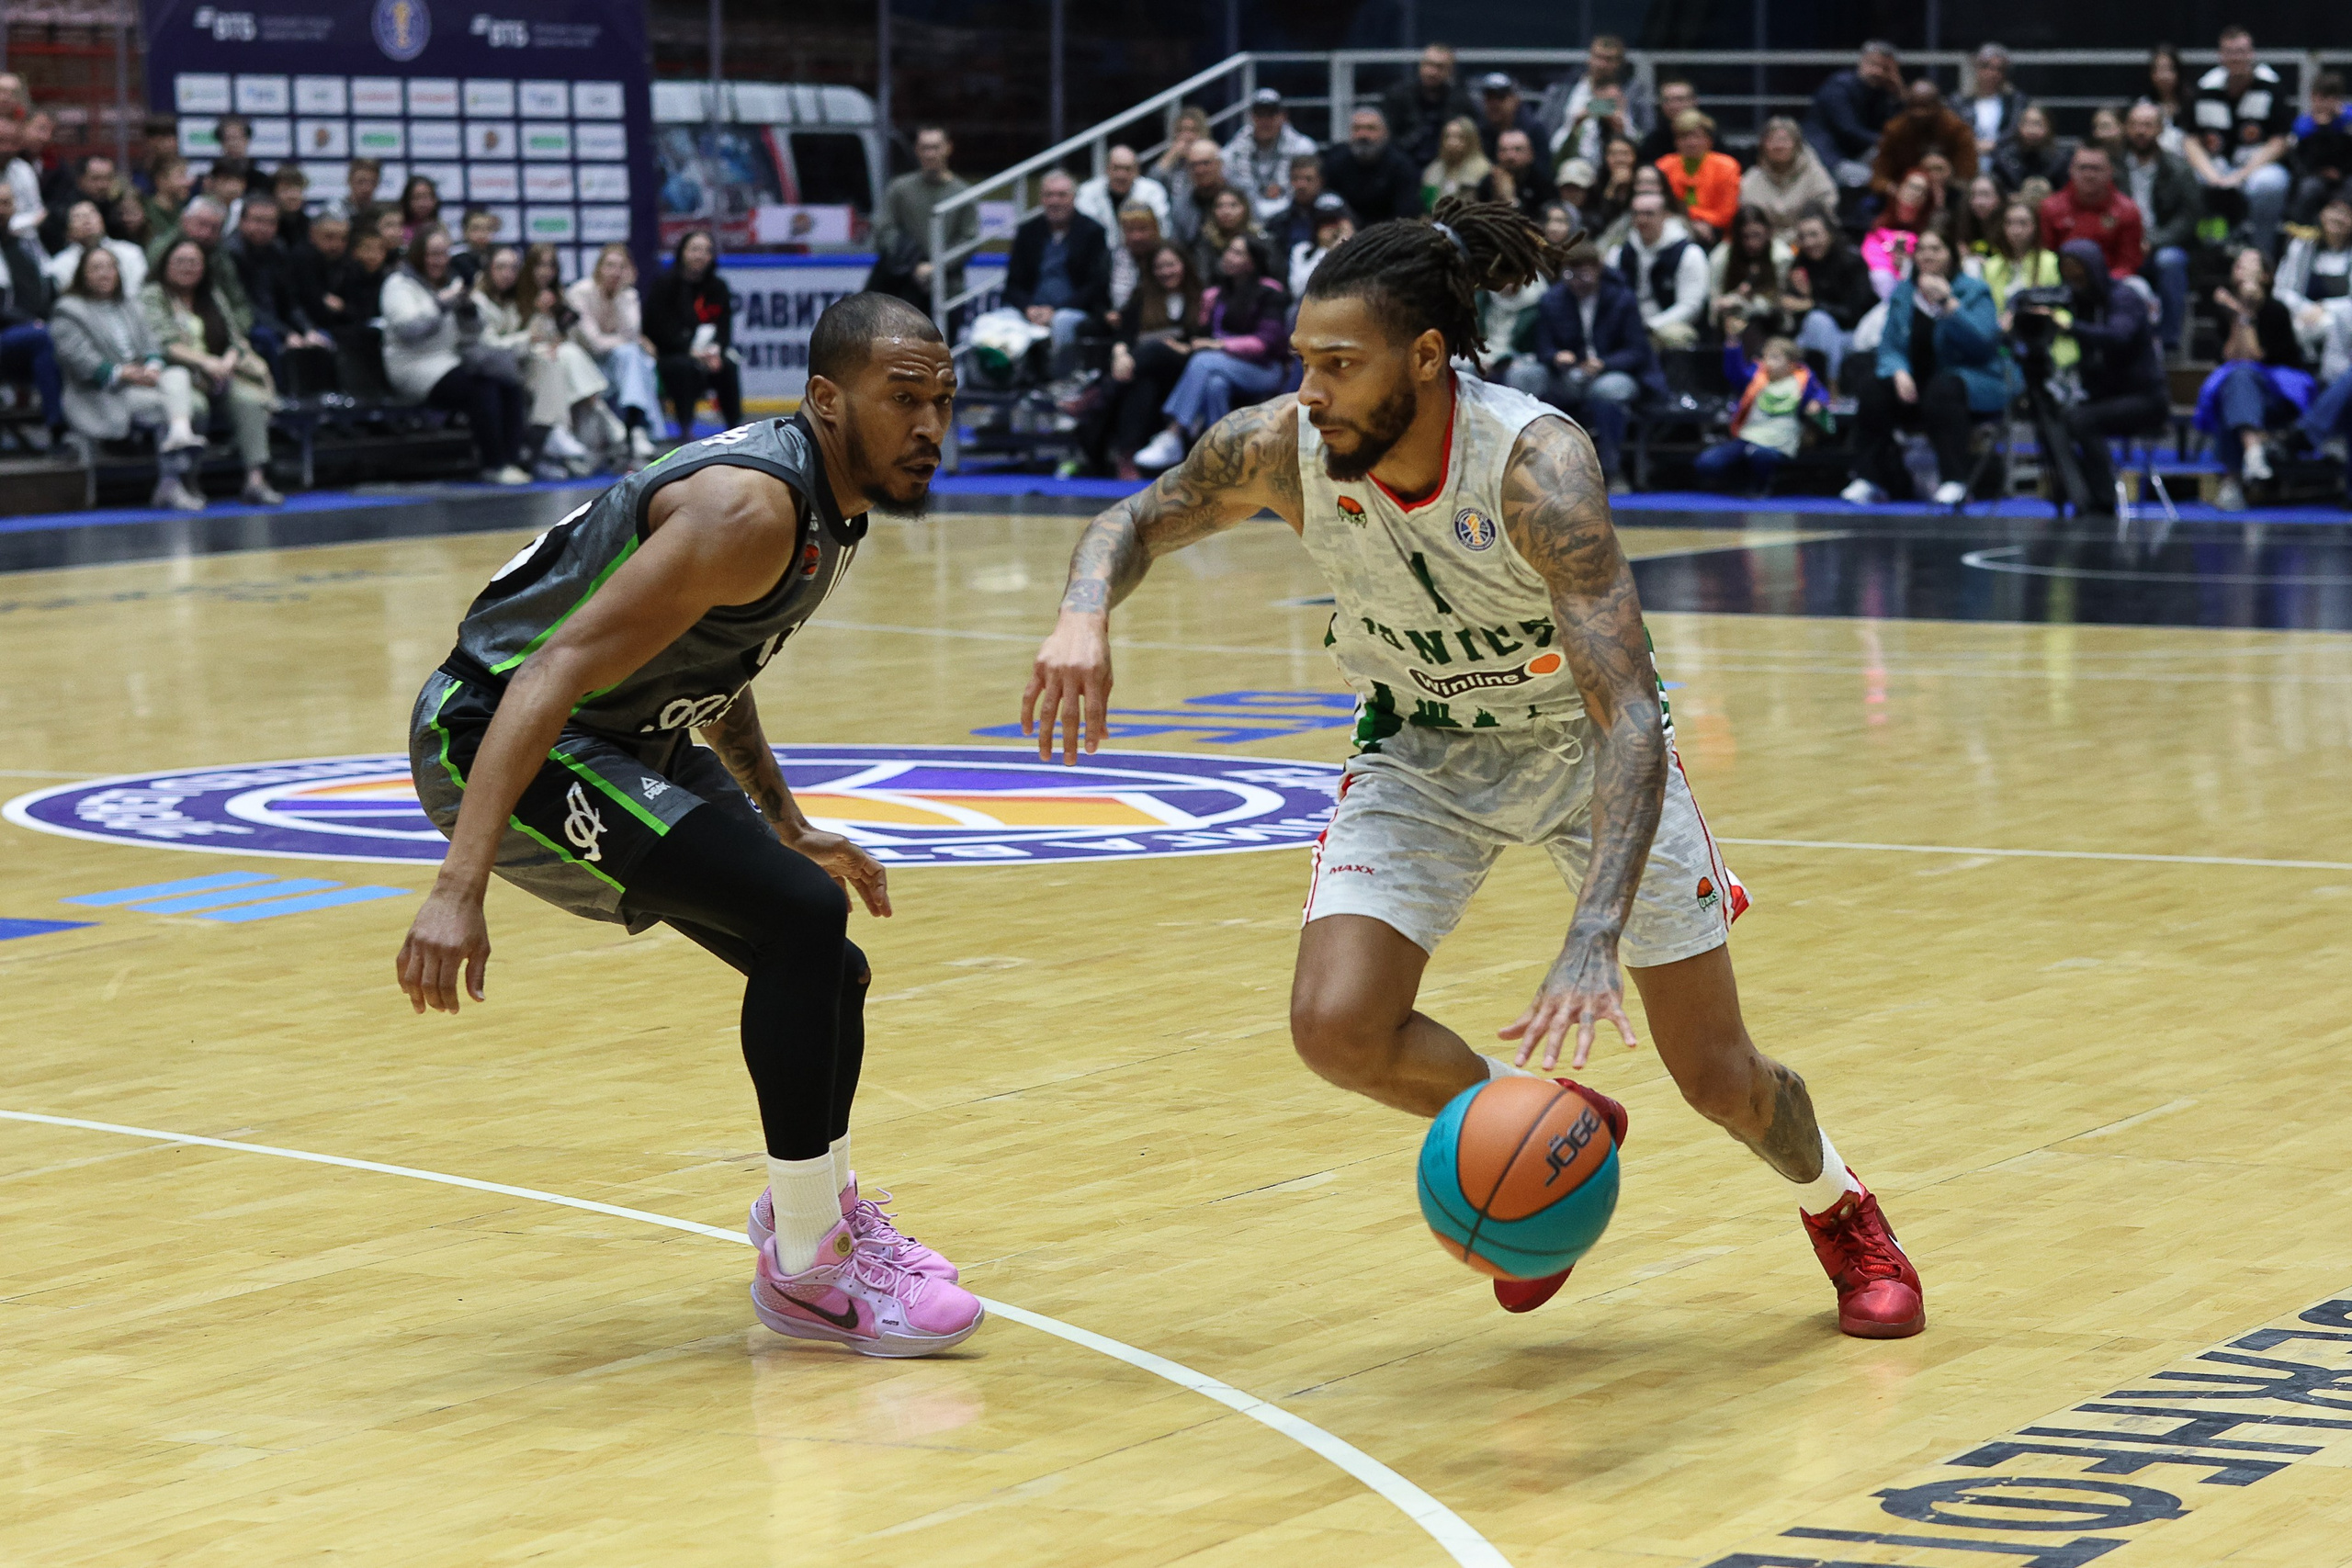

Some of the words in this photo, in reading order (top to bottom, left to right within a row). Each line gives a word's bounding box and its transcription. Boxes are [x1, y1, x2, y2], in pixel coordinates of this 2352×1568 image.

[1412, 551, 1452, 615] 1
[1416, 672, 1520, 695] Winline
[643, 781, 672, 801] PEAK
[1329, 863, 1375, 875] MAXX
